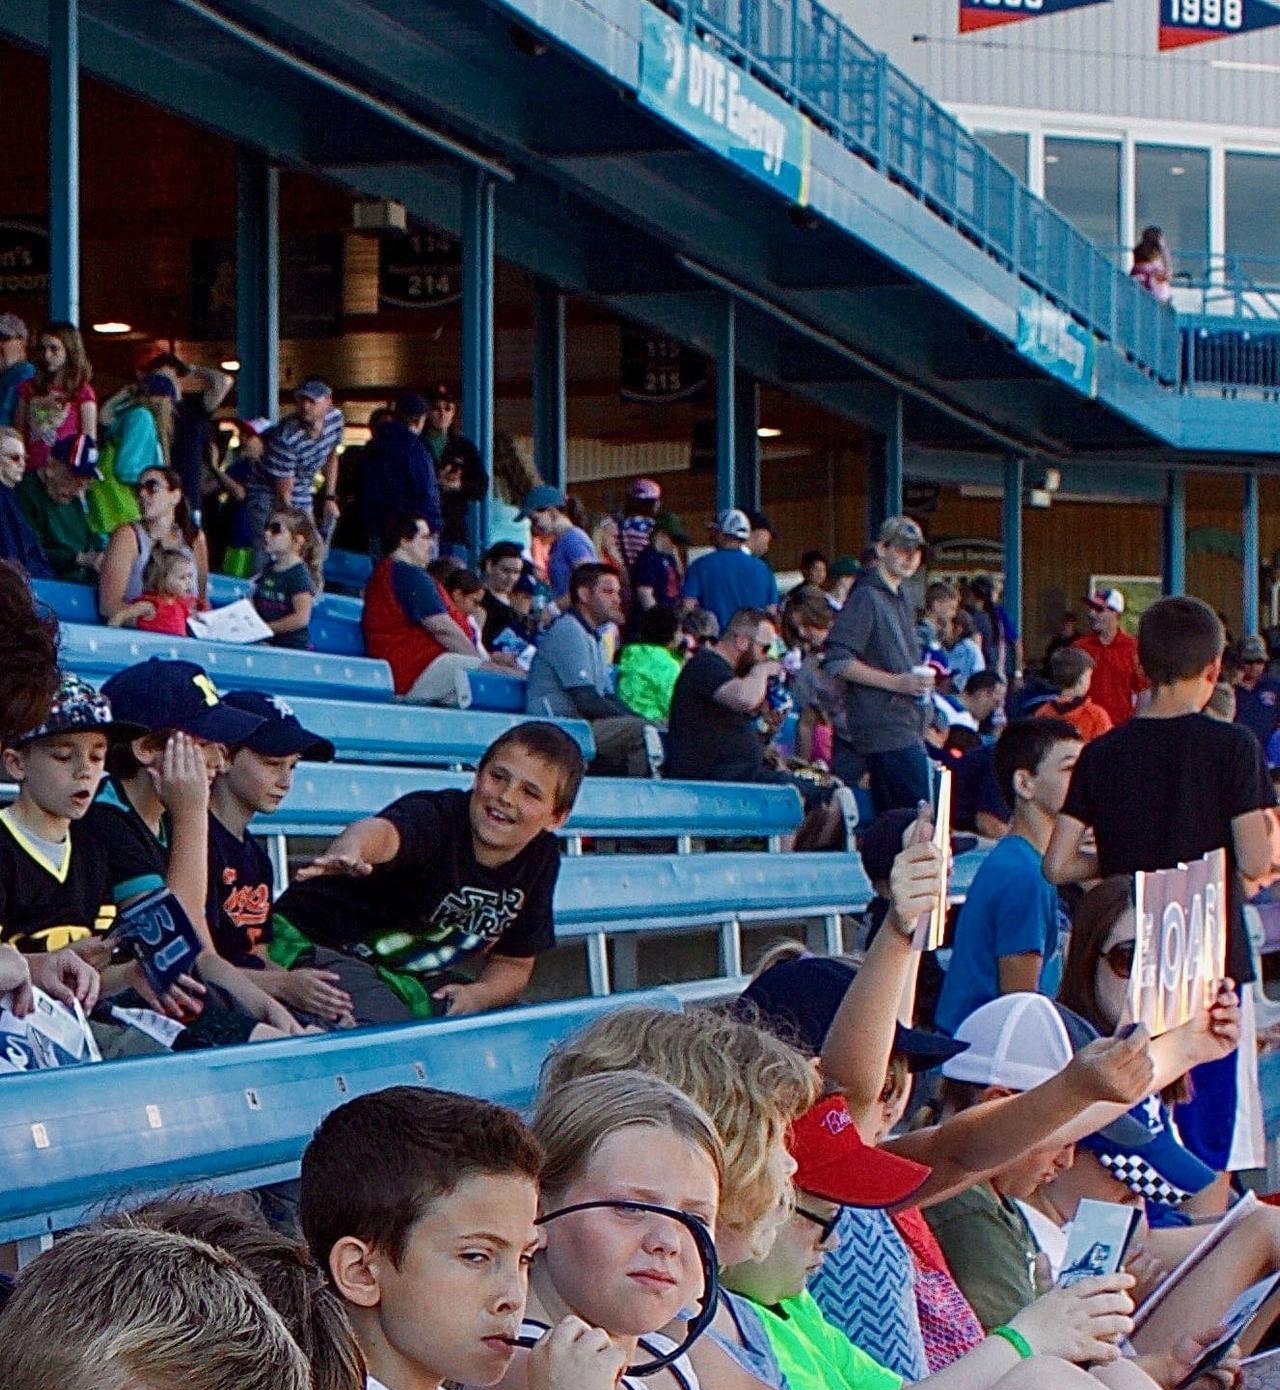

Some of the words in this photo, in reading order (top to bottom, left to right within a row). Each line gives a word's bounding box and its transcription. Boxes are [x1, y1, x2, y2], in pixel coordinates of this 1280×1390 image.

[1169, 0, 1244, 29] 1998
[687, 42, 726, 125] DTE
[726, 69, 787, 177] Energy
[408, 274, 450, 296] 214
